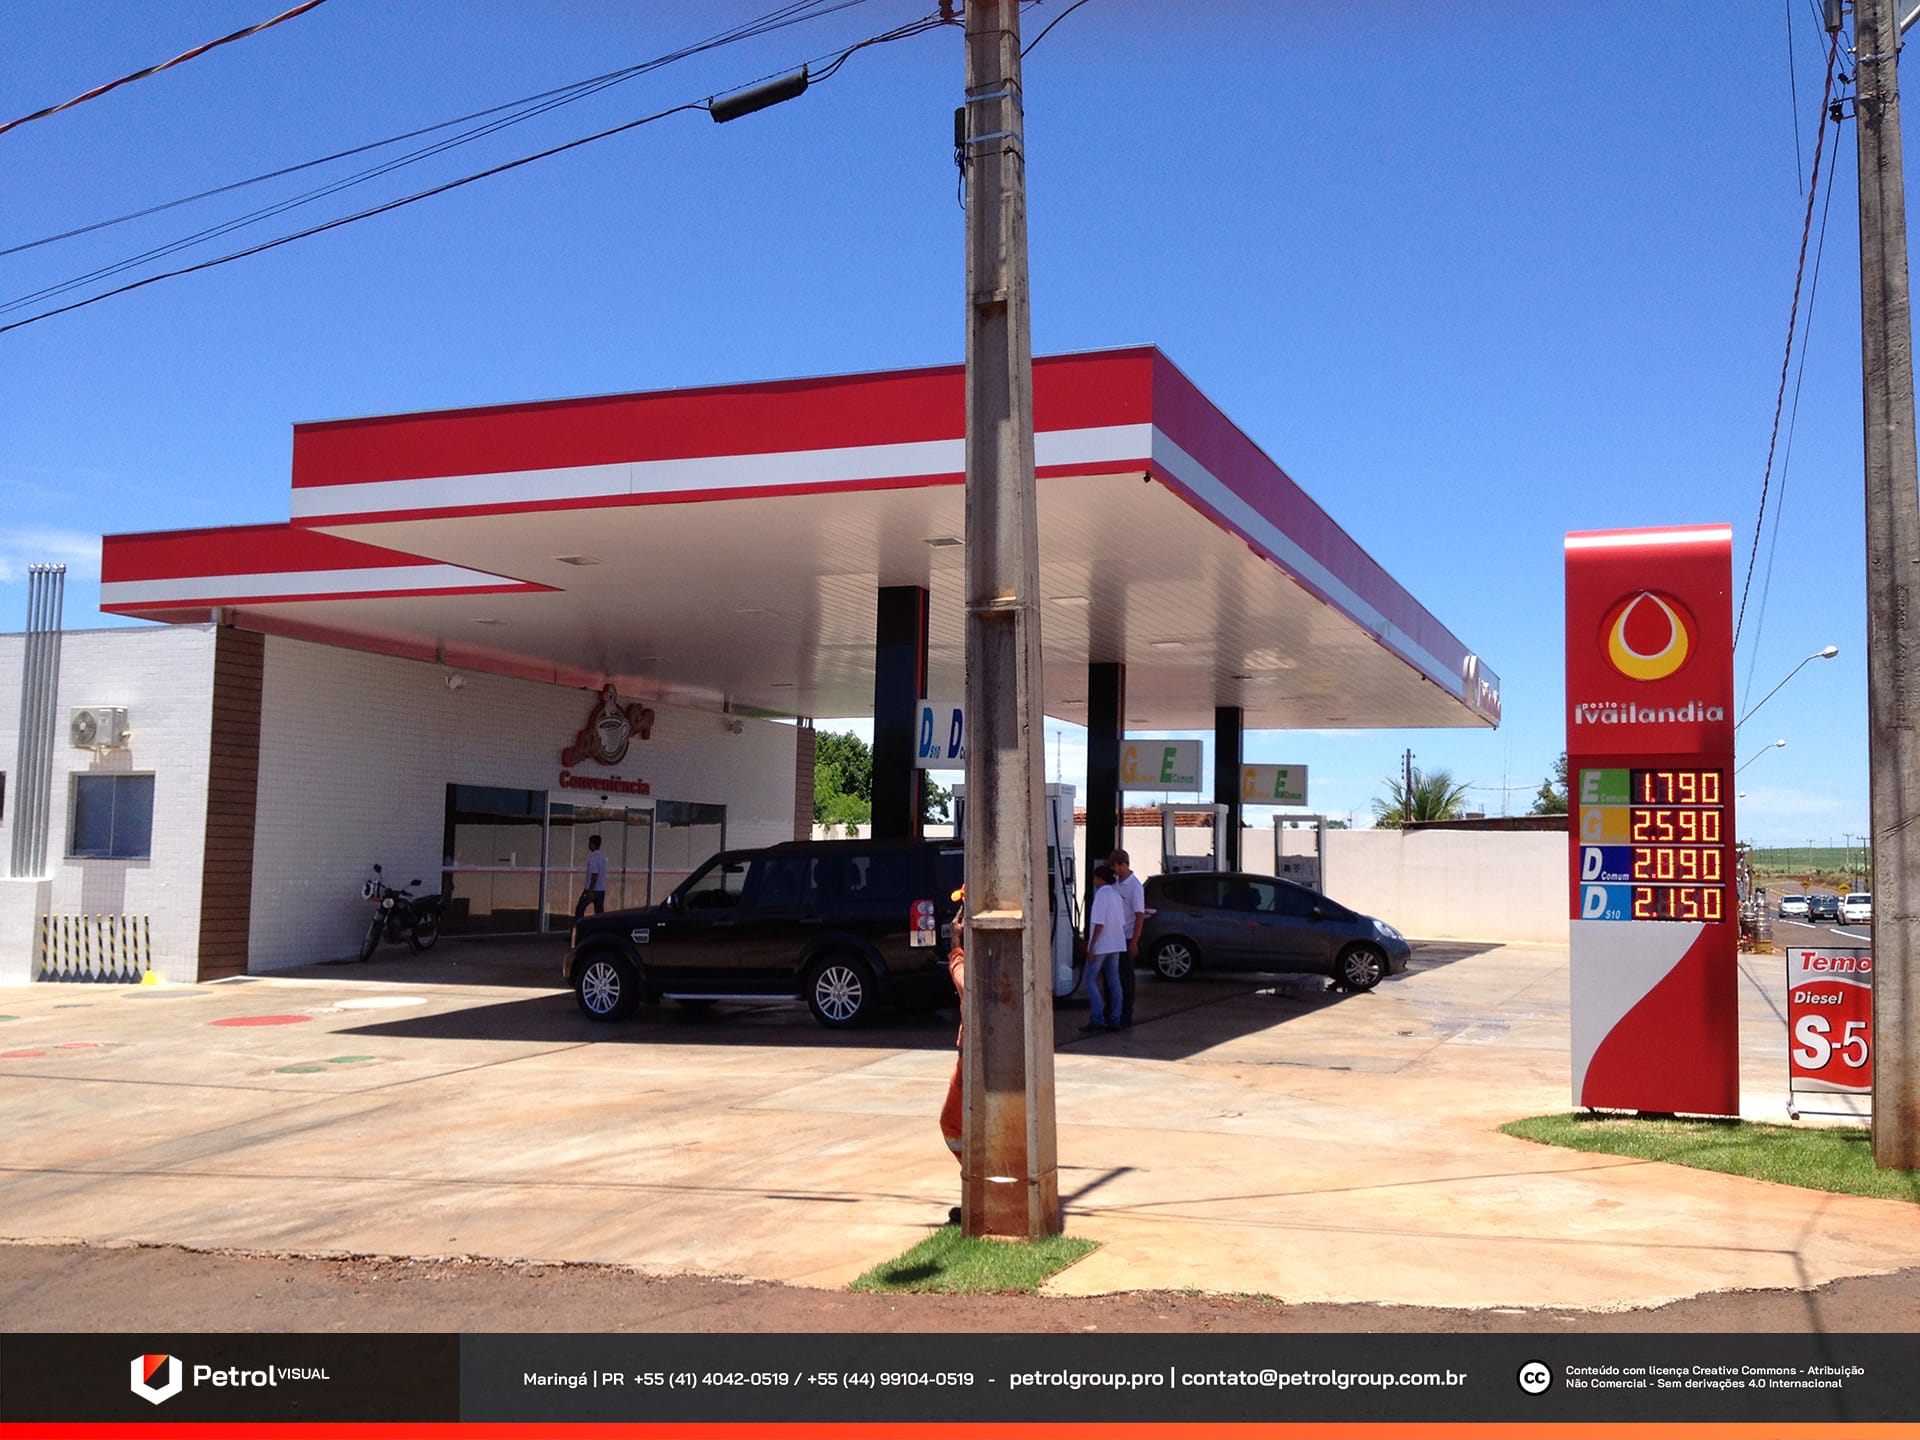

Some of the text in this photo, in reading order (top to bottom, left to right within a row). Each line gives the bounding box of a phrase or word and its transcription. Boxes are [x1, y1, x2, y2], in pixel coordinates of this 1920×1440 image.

[1575, 701, 1723, 724] Ivailandia
[1582, 702, 1617, 710] posto
[919, 707, 933, 758] D
[947, 708, 963, 758] D
[1121, 745, 1137, 784] G
[1160, 747, 1177, 783] E
[1274, 769, 1288, 798] E
[1582, 771, 1601, 802] E
[1645, 772, 1719, 803] 1.790
[1582, 809, 1719, 841] G 2.590
[1582, 847, 1720, 880] D Comum 2.090
[1582, 886, 1720, 920] D S10 2.150
[1794, 991, 1843, 1004] Diesel
[1792, 1014, 1872, 1070] S-5
